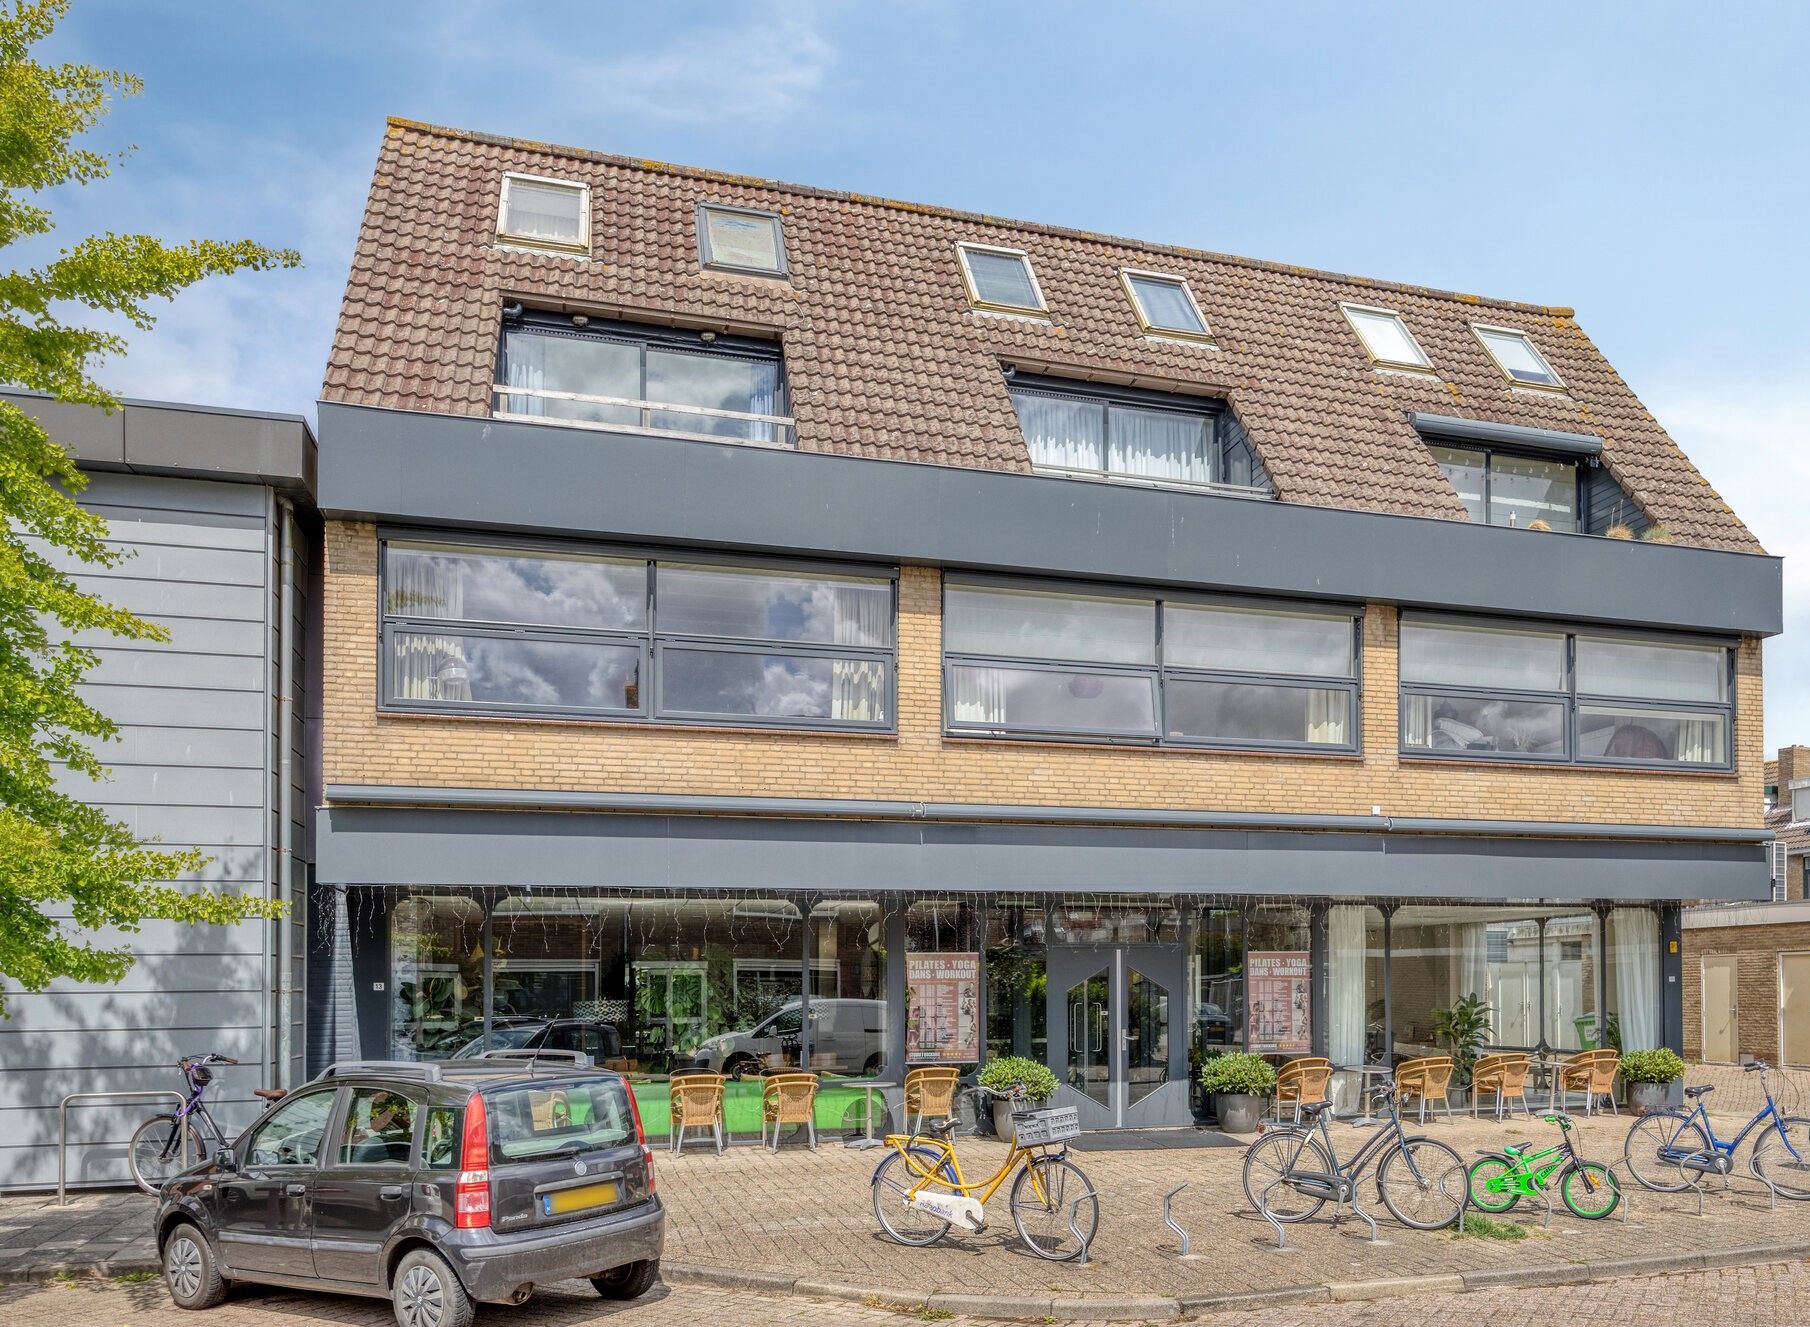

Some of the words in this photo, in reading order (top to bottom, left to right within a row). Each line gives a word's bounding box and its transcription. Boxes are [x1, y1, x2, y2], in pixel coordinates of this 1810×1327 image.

[909, 960, 945, 970] PILATES
[952, 960, 977, 970] YOGA
[1249, 958, 1281, 967] PILATES
[1286, 958, 1307, 967] YOGA
[909, 969, 932, 979] DANS
[935, 969, 977, 979] WORKOUT
[1249, 967, 1269, 976] DANS
[1272, 967, 1308, 976] WORKOUT
[501, 1213, 529, 1222] Panda
